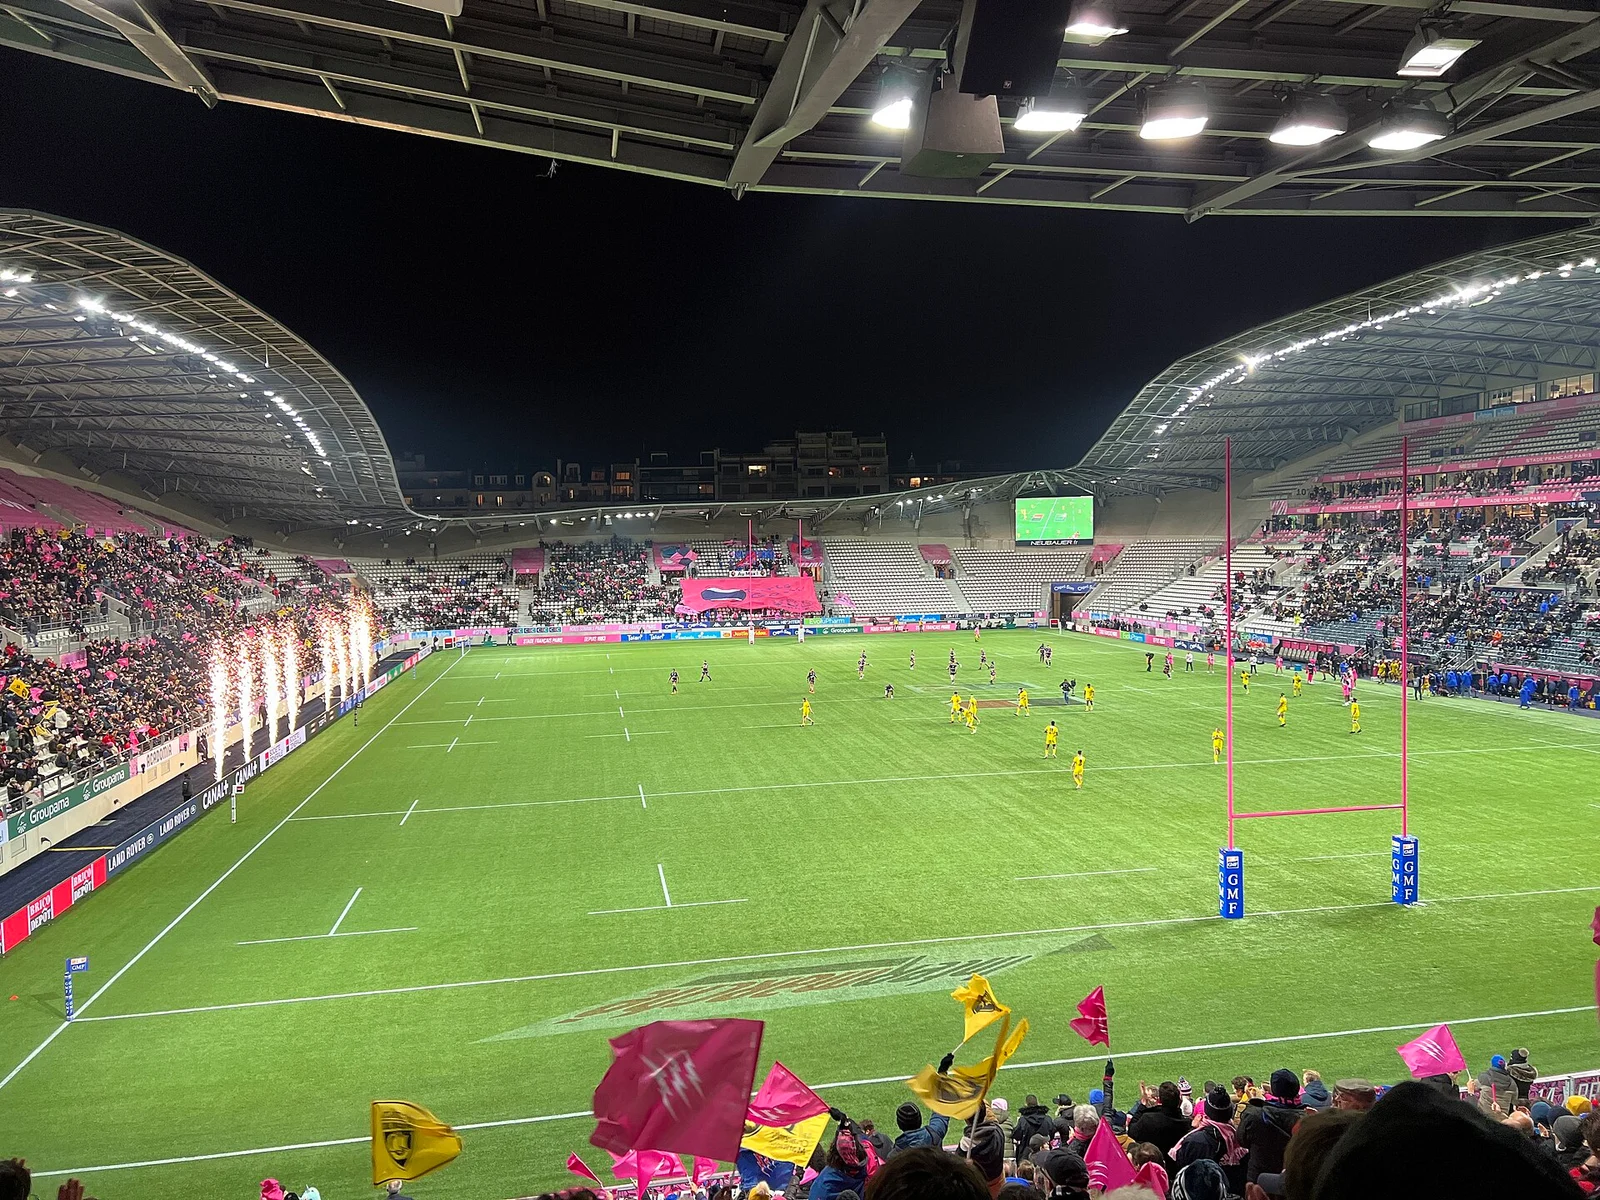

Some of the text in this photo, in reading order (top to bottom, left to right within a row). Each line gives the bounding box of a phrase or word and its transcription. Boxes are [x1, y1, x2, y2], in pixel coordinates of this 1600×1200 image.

[92, 769, 125, 793] Groupama
[235, 760, 258, 785] CANAL+
[202, 780, 229, 810] CANAL+
[29, 796, 70, 824] Groupama
[159, 807, 190, 837] LAND ROVER
[108, 836, 146, 872] LAND ROVER
[73, 867, 92, 886] BRICO
[1403, 861, 1415, 900] GMF
[29, 894, 51, 916] BRICO
[1227, 873, 1239, 914] GMF
